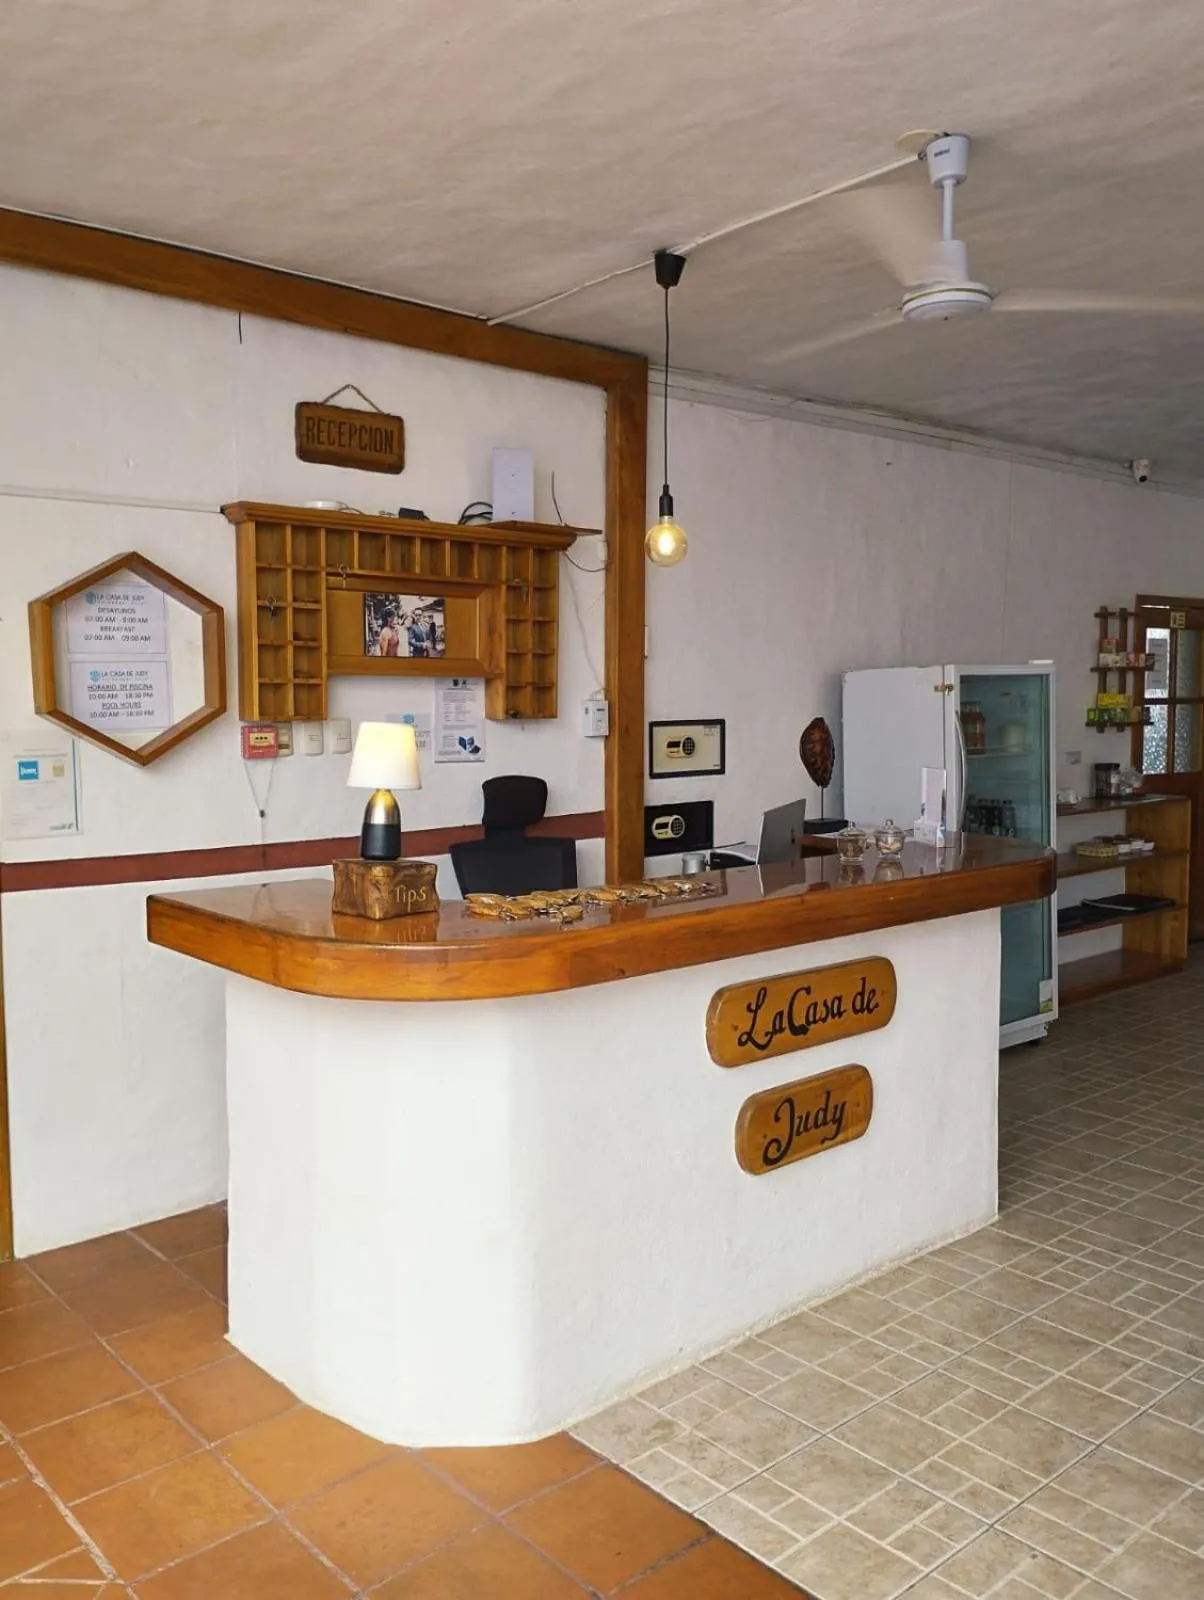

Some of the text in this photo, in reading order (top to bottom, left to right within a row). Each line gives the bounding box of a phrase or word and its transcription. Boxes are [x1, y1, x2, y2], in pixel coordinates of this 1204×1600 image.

[305, 416, 394, 454] RECEPCION
[97, 607, 136, 615] DESAYUNOS
[120, 701, 142, 709] HOURS
[737, 976, 880, 1051] La Casa de
[762, 1090, 847, 1167] Judy
